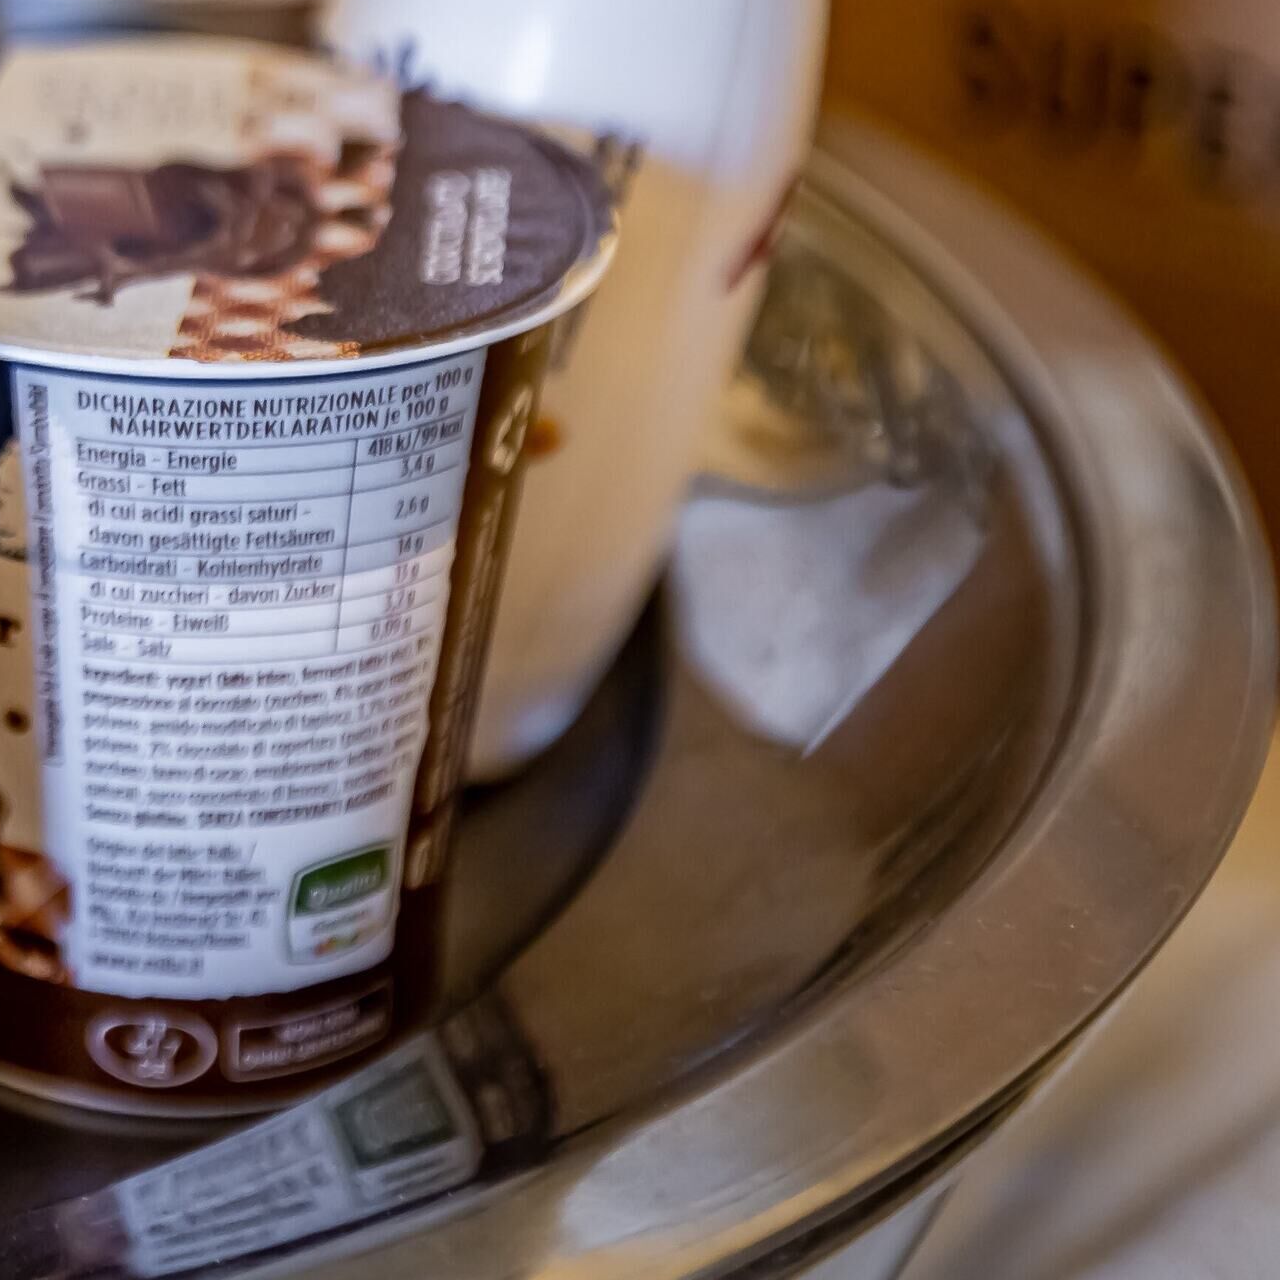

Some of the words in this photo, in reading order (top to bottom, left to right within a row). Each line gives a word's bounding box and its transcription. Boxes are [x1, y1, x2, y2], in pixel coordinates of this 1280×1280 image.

[254, 385, 398, 418] NUTRIZIONALE
[401, 381, 430, 404] per
[434, 368, 461, 393] 100
[406, 396, 436, 421] 100
[76, 442, 147, 469] Energia
[167, 449, 238, 473] Energie
[77, 470, 131, 494] Grassi
[152, 477, 187, 498] Fett
[88, 499, 105, 517] di
[141, 504, 184, 522] acidi
[189, 505, 242, 527] grassi
[247, 503, 298, 523] saturi
[88, 525, 144, 547] davon
[196, 554, 323, 579] Kohlenhydrate
